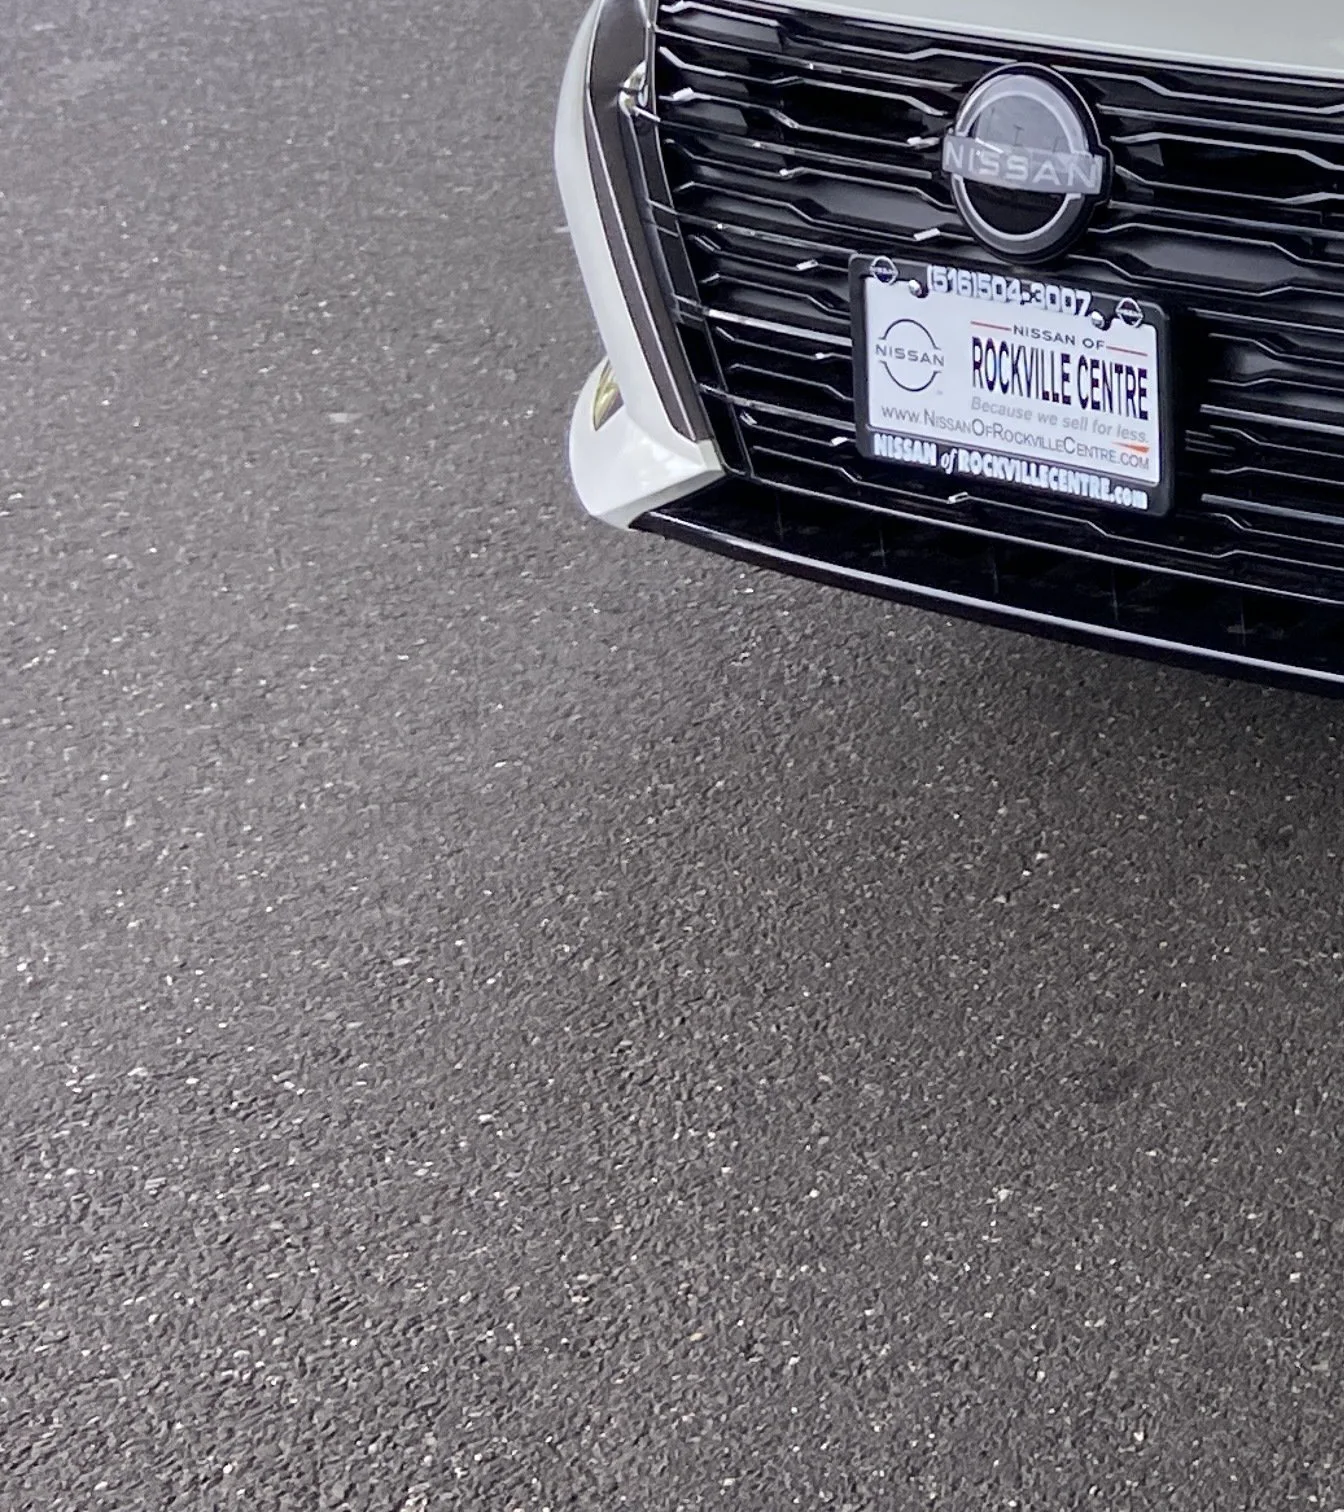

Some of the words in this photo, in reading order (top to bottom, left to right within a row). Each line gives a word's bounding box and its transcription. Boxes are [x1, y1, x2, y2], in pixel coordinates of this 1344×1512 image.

[944, 140, 1102, 189] NISSAN
[875, 343, 945, 368] NISSAN
[1013, 324, 1076, 346] NISSAN
[1082, 337, 1106, 351] OF
[971, 336, 1072, 406] ROCKVILLE
[1077, 354, 1149, 421] CENTRE
[970, 395, 1033, 421] Because
[1037, 412, 1058, 426] we
[1062, 416, 1089, 431] sell
[1092, 419, 1113, 436] for
[873, 432, 937, 467] NISSAN
[940, 447, 958, 475] of
